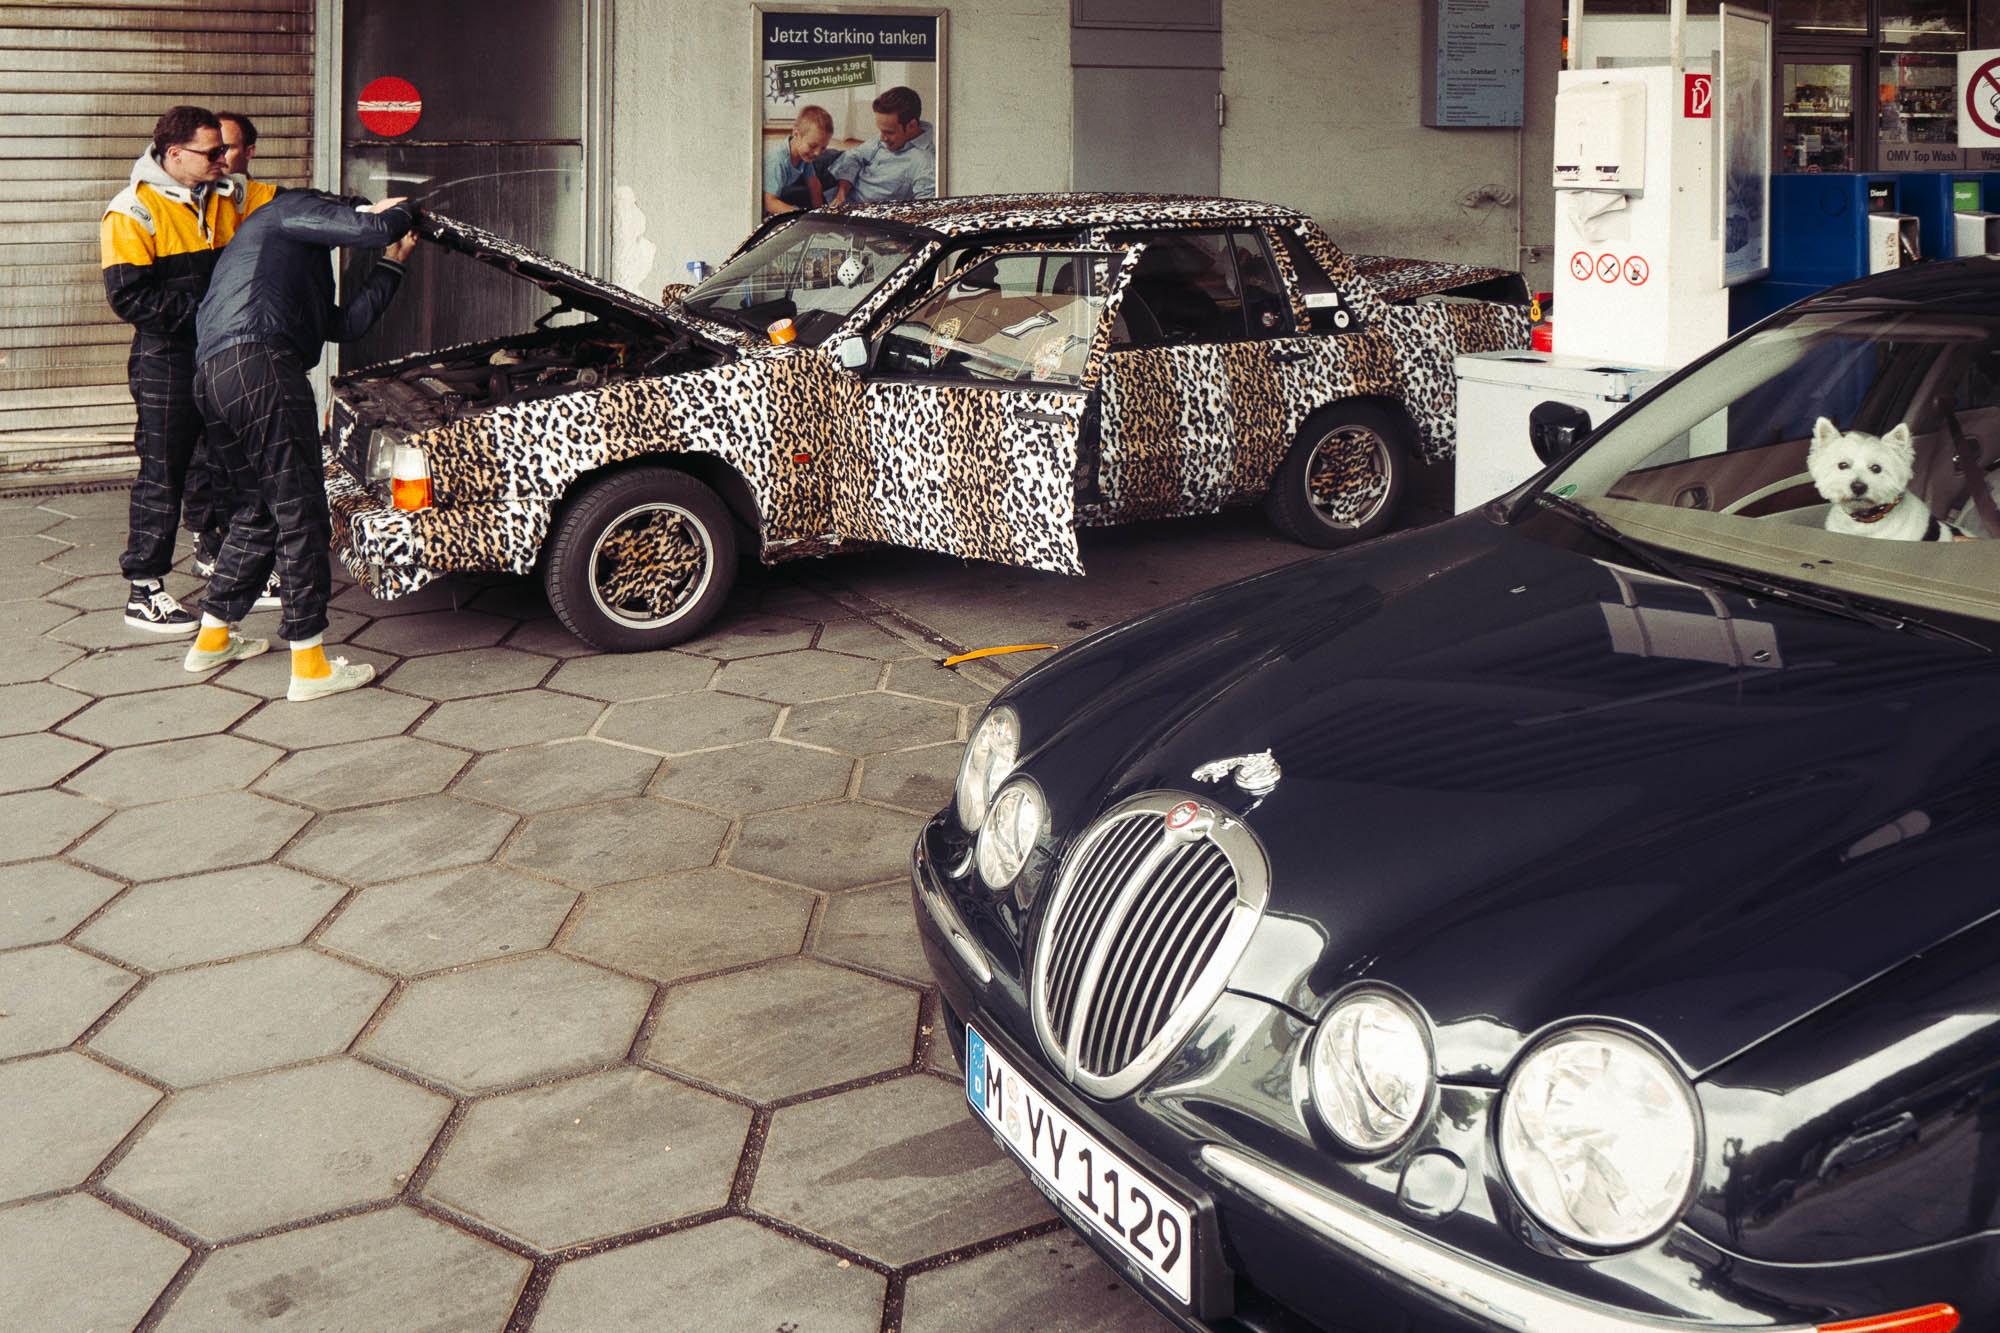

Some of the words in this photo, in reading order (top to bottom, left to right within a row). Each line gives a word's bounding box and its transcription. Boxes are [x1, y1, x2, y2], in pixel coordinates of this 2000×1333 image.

[769, 26, 809, 43] Jetzt
[813, 26, 875, 44] Starkino
[879, 29, 927, 45] tanken
[783, 70, 789, 79] 3
[791, 66, 834, 78] Sternchen
[842, 62, 860, 72] 3,99
[793, 79, 798, 87] 1
[1886, 150, 1911, 161] OMV
[1914, 150, 1930, 164] Top
[1932, 149, 1957, 161] Wash
[1870, 188, 1888, 197] Diesel
[974, 1074, 982, 1095] D
[986, 1054, 1002, 1122] M
[1025, 1094, 1067, 1180] YY
[1077, 1147, 1182, 1274] 1129
